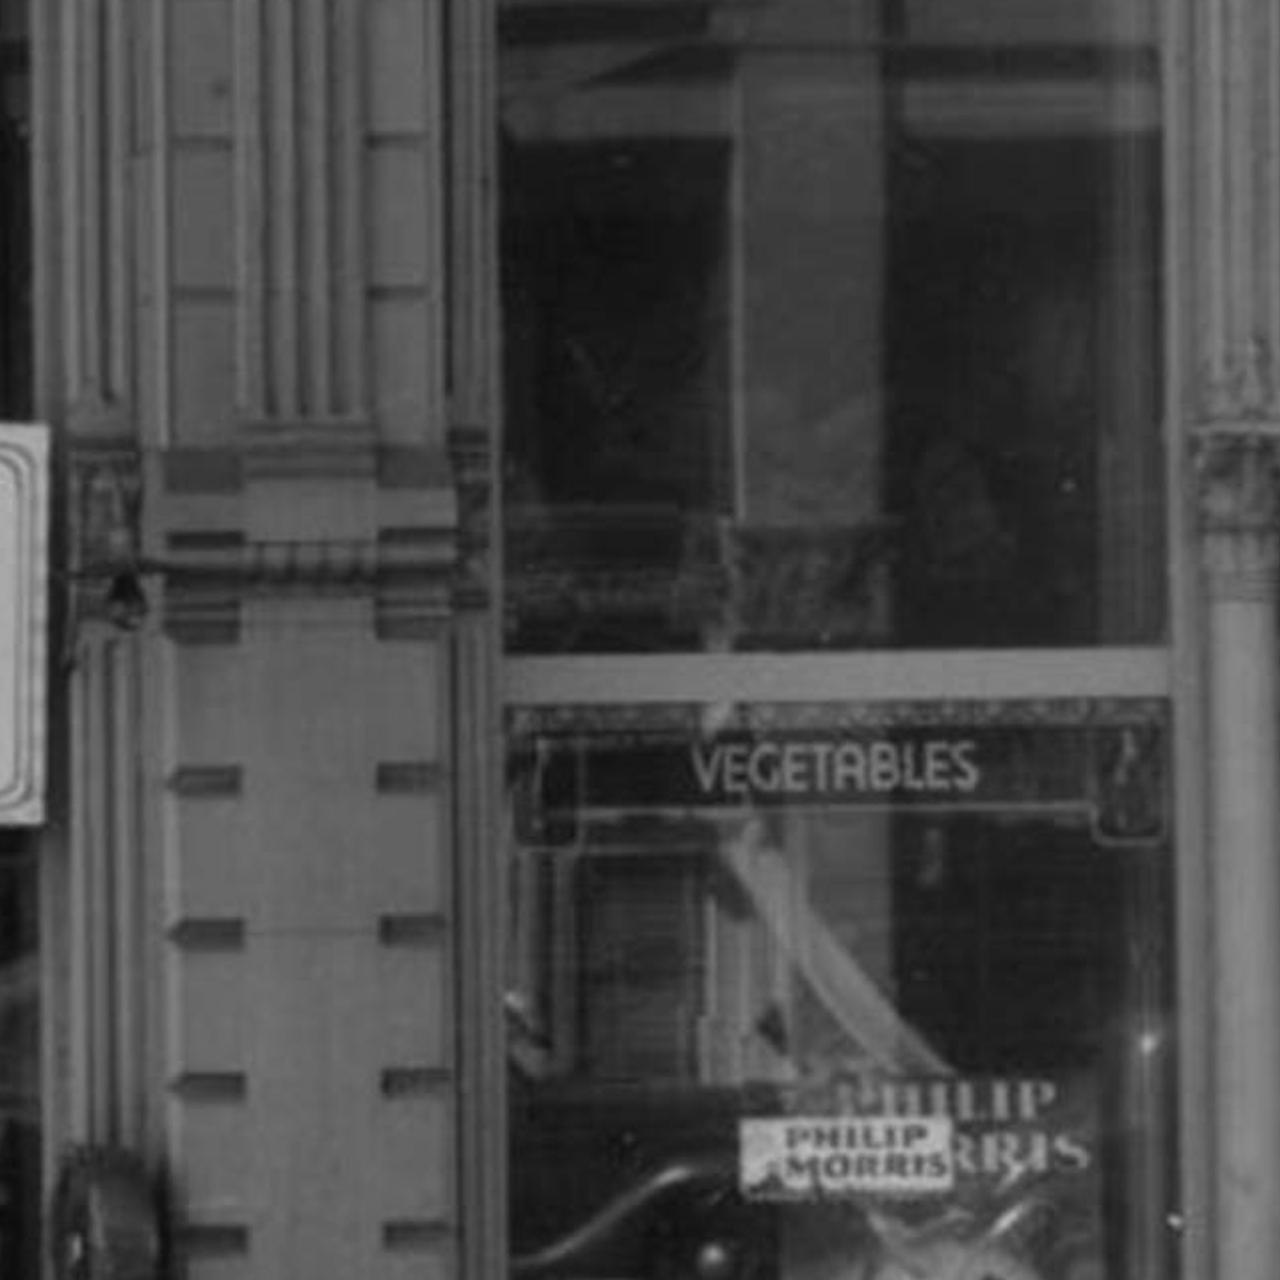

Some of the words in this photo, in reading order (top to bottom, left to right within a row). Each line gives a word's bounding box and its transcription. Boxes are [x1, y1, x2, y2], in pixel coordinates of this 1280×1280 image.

[692, 740, 980, 793] VEGETABLES
[785, 1124, 928, 1150] PHILIP
[785, 1152, 948, 1180] MORRIS
